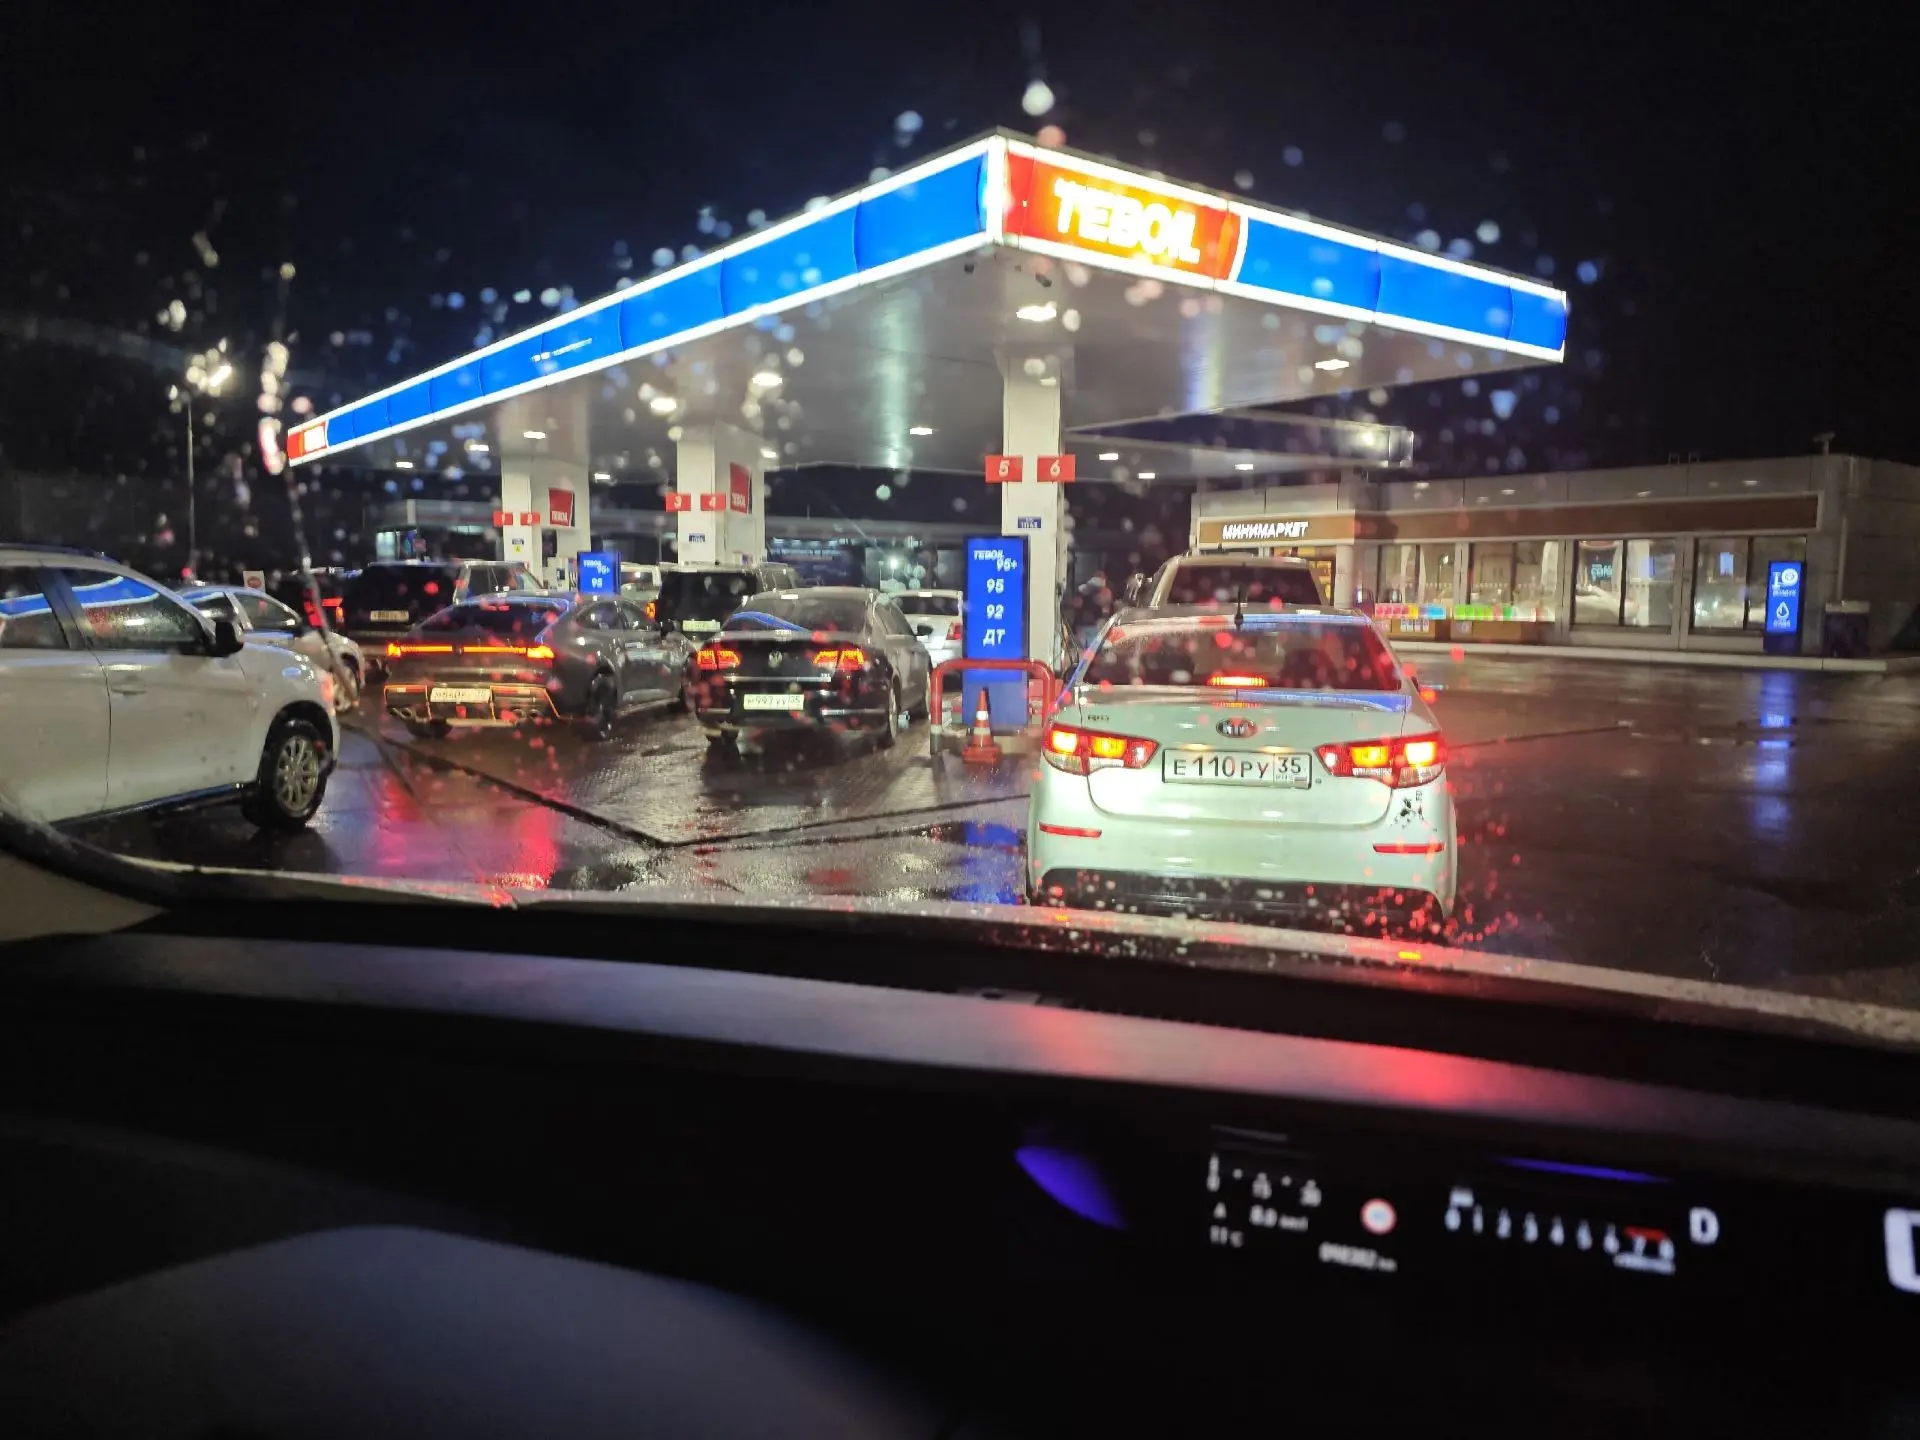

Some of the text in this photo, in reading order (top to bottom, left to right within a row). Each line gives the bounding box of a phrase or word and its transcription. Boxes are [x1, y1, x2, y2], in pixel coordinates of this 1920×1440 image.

[999, 459, 1010, 478] 5
[1050, 459, 1061, 477] 6
[1222, 521, 1309, 540] МИНИМАРКЕТ
[986, 578, 1005, 594] 95
[986, 604, 1005, 620] 92
[983, 628, 1006, 647] ДТ
[1278, 756, 1302, 774] 35
[1689, 1206, 1719, 1244] D
